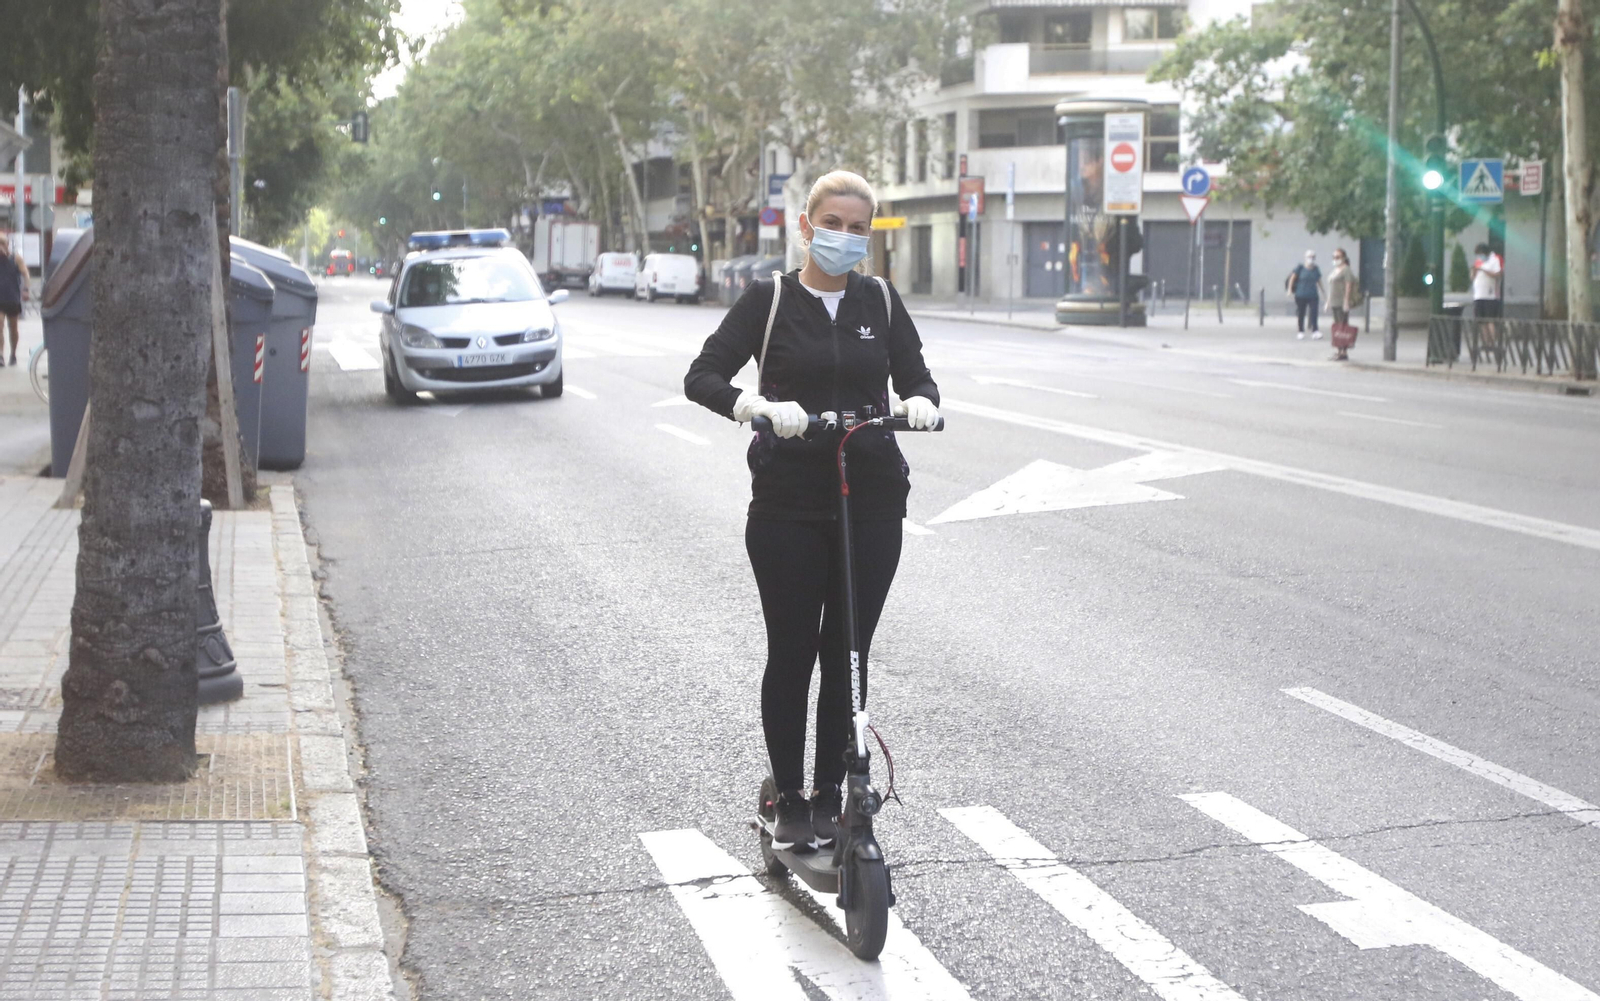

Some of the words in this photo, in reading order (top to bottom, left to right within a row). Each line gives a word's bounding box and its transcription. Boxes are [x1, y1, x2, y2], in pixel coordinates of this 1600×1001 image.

[464, 354, 486, 364] 4770
[490, 353, 506, 363] GZK
[850, 650, 861, 713] MOVERACE
